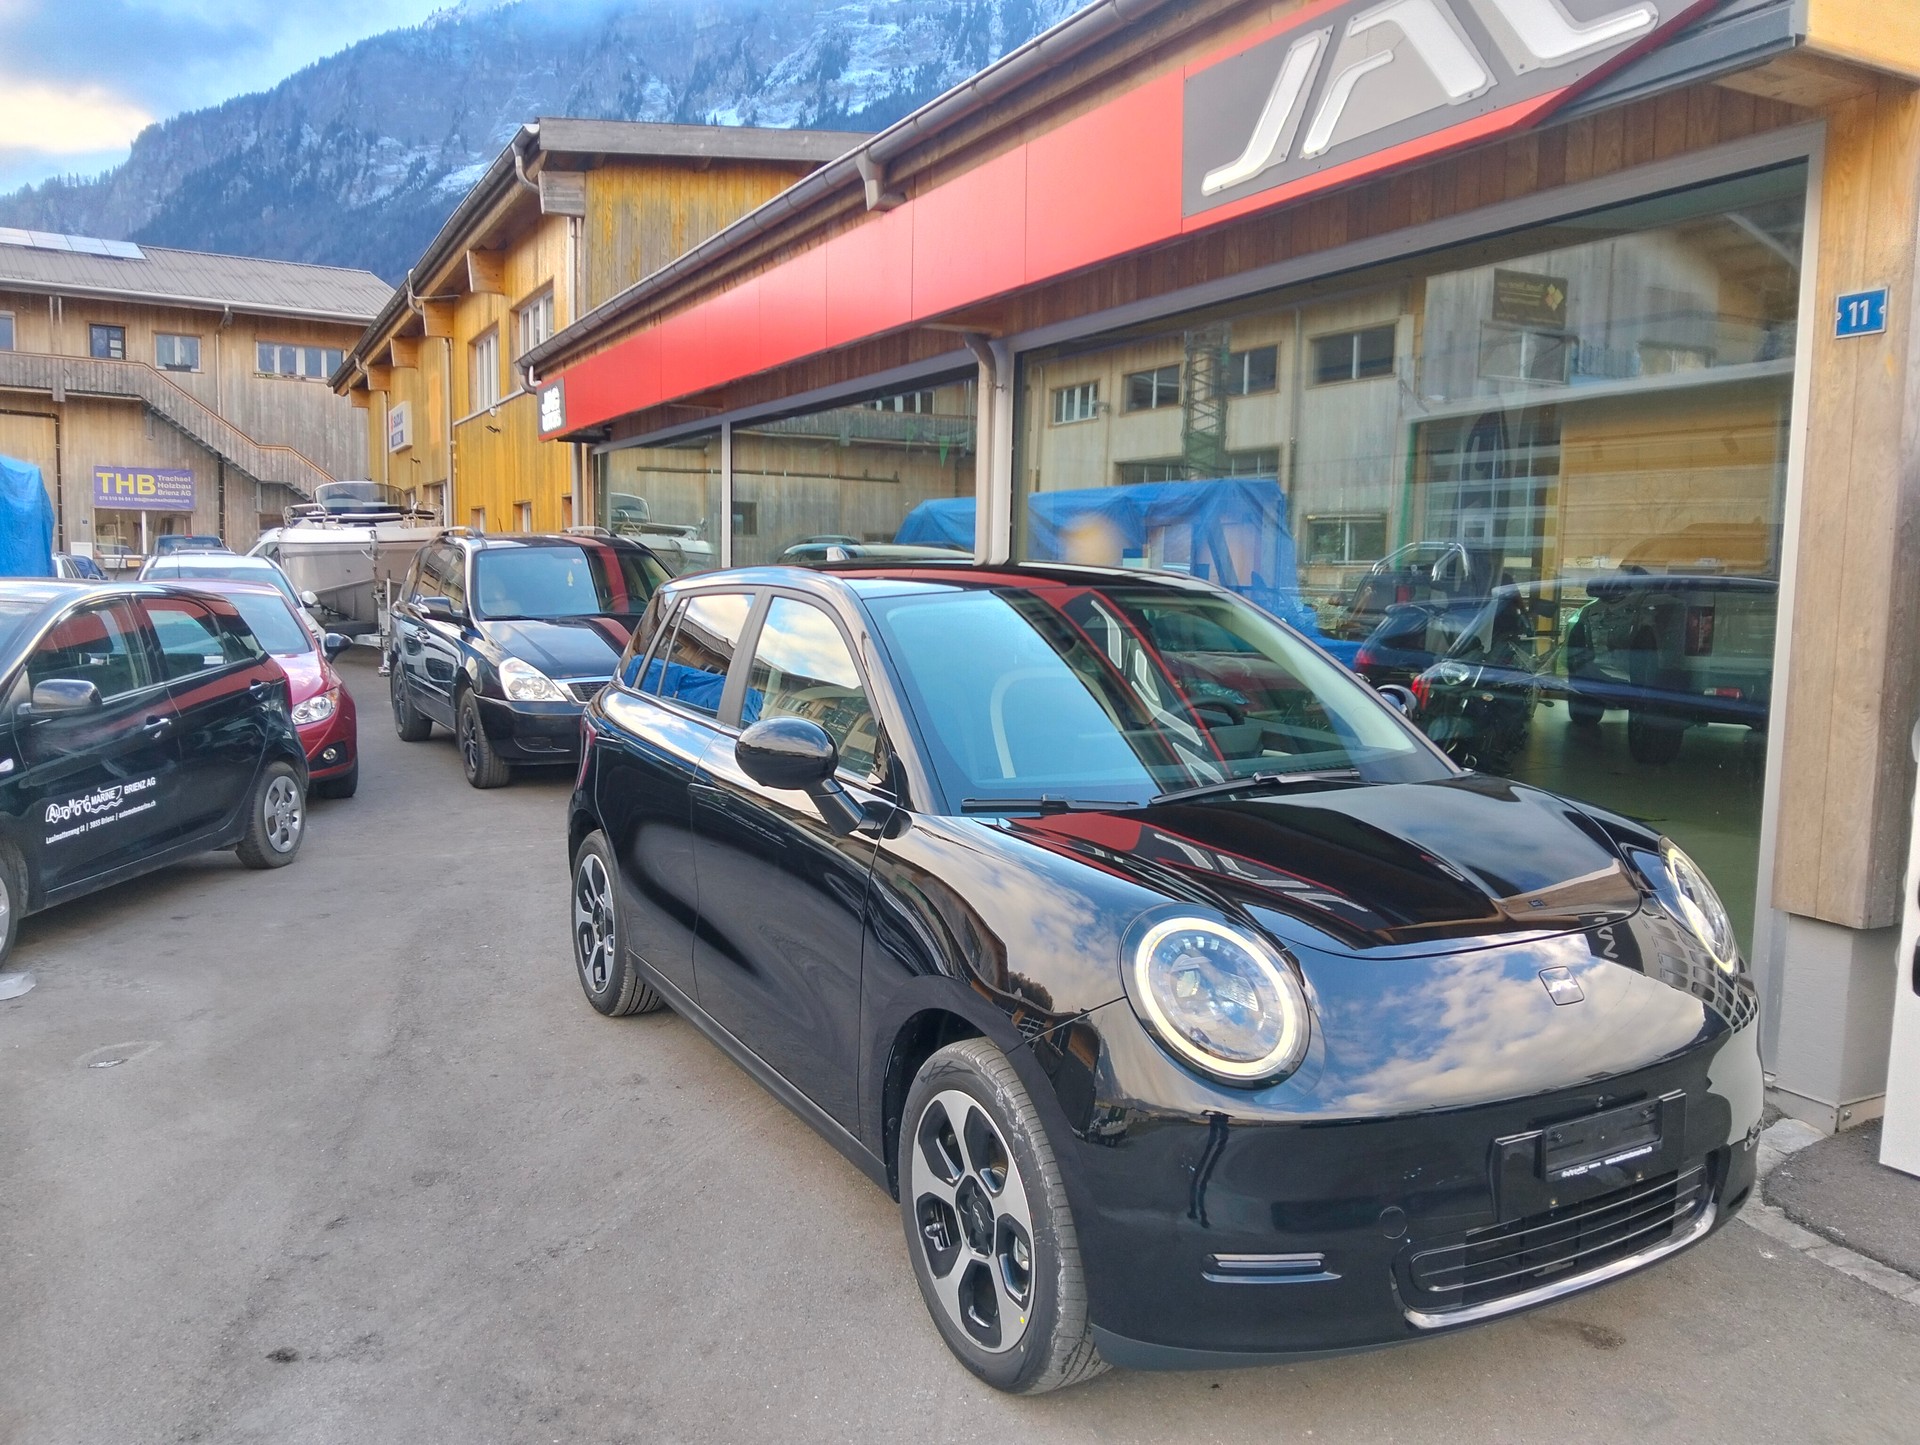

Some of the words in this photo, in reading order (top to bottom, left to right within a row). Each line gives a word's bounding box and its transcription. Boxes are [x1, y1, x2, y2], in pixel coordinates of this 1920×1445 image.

[1849, 299, 1869, 327] 11
[96, 472, 156, 495] THB
[91, 790, 116, 805] MARINE
[124, 779, 147, 795] BRIENZ
[146, 777, 156, 788] AG
